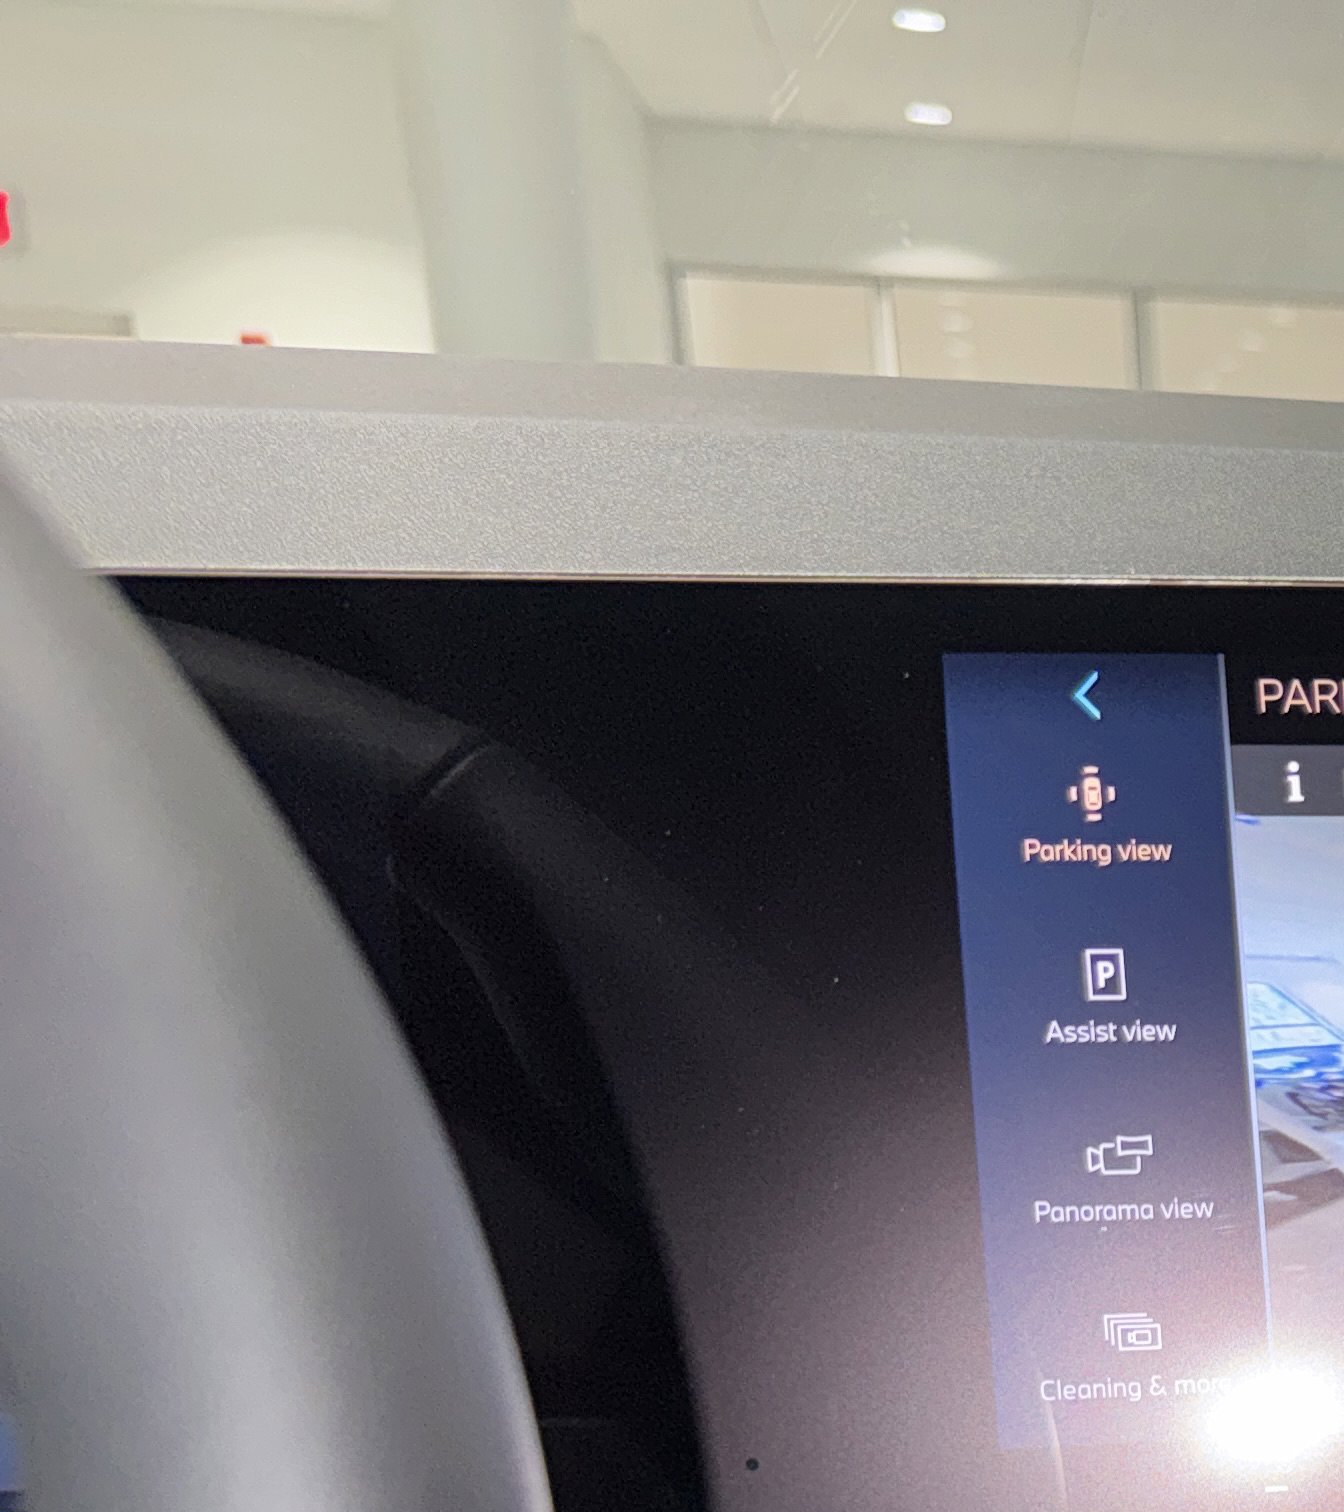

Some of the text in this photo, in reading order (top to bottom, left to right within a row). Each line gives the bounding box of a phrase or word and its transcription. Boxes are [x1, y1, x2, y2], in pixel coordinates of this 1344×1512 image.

[1022, 837, 1174, 867] Parking view
[1045, 1018, 1178, 1044] Assist view
[1034, 1196, 1215, 1224] Panorama view
[1040, 1376, 1142, 1402] Cleaning
[1150, 1374, 1168, 1397] &
